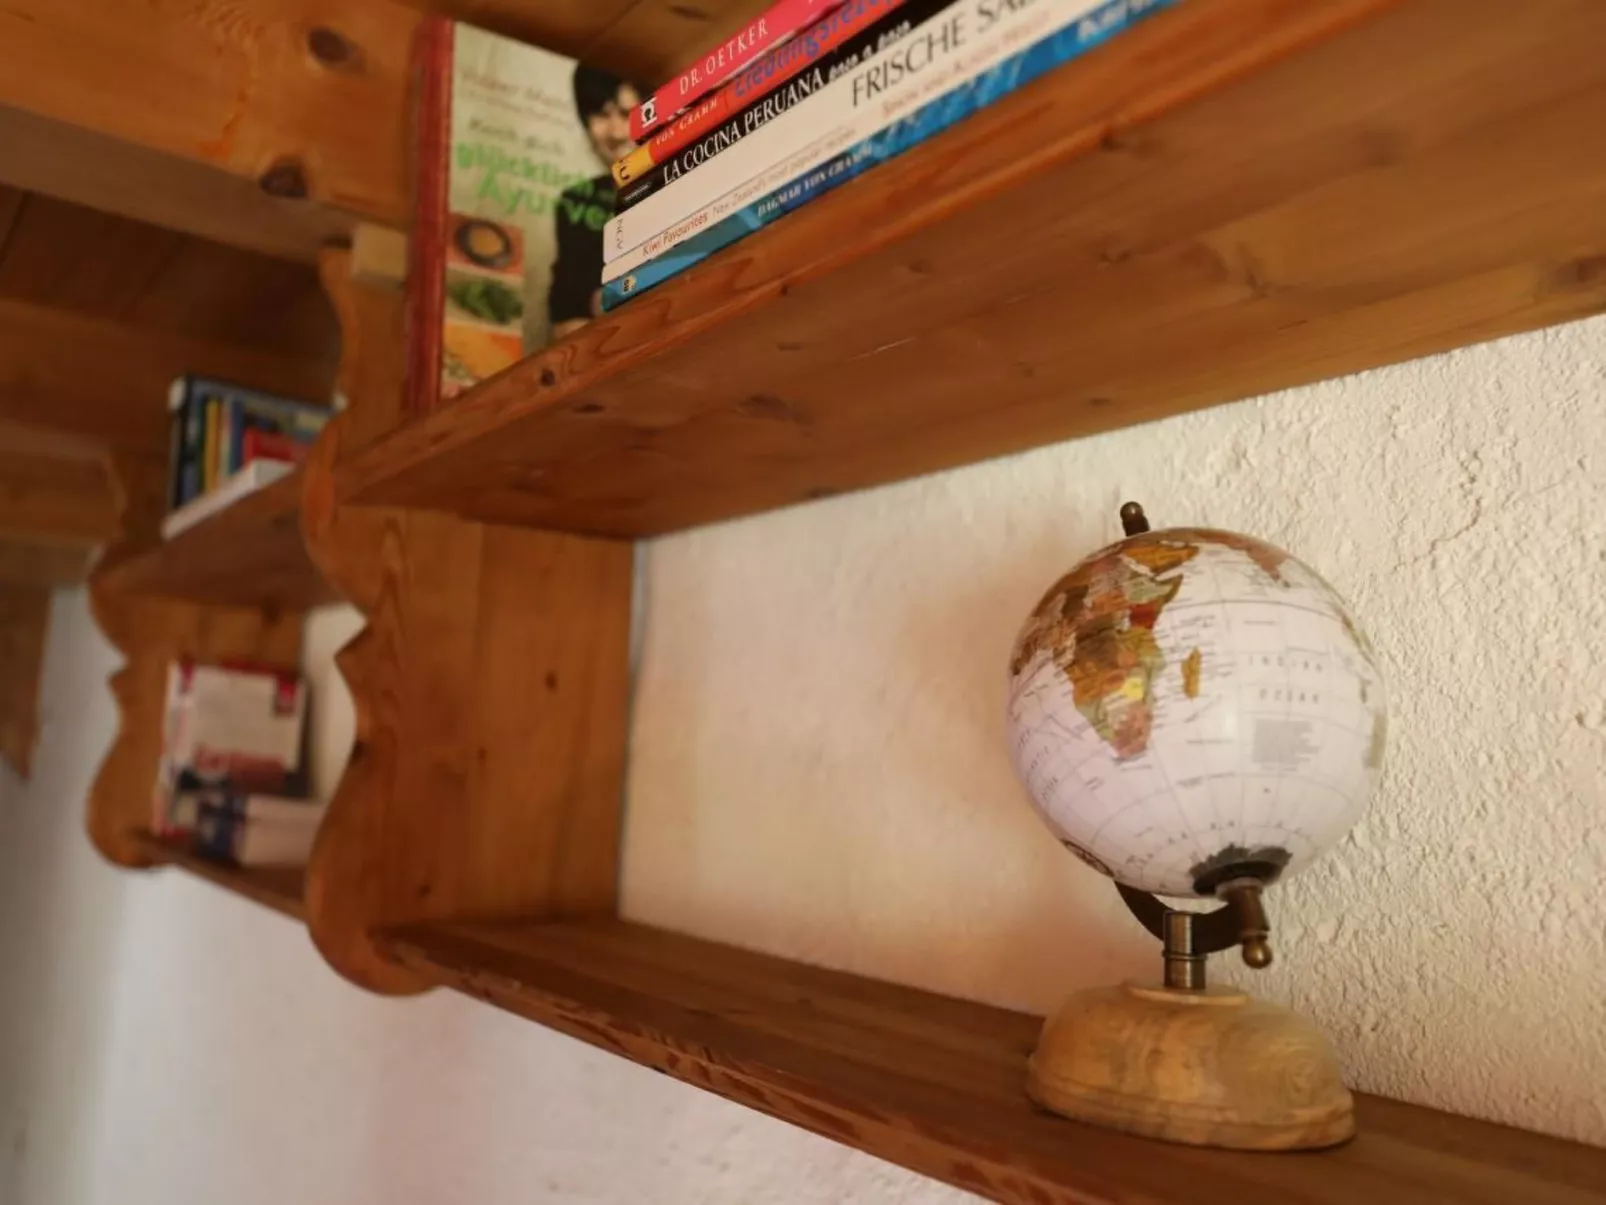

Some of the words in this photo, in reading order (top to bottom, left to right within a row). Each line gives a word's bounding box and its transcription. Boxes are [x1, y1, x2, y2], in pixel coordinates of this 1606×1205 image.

[679, 71, 703, 95] DR.
[706, 18, 769, 74] OETKER
[852, 11, 966, 107] FRISCHE
[663, 159, 683, 185] LA
[683, 121, 742, 171] COCINA
[743, 67, 826, 136] PERUANA
[663, 214, 708, 246] Favourites
